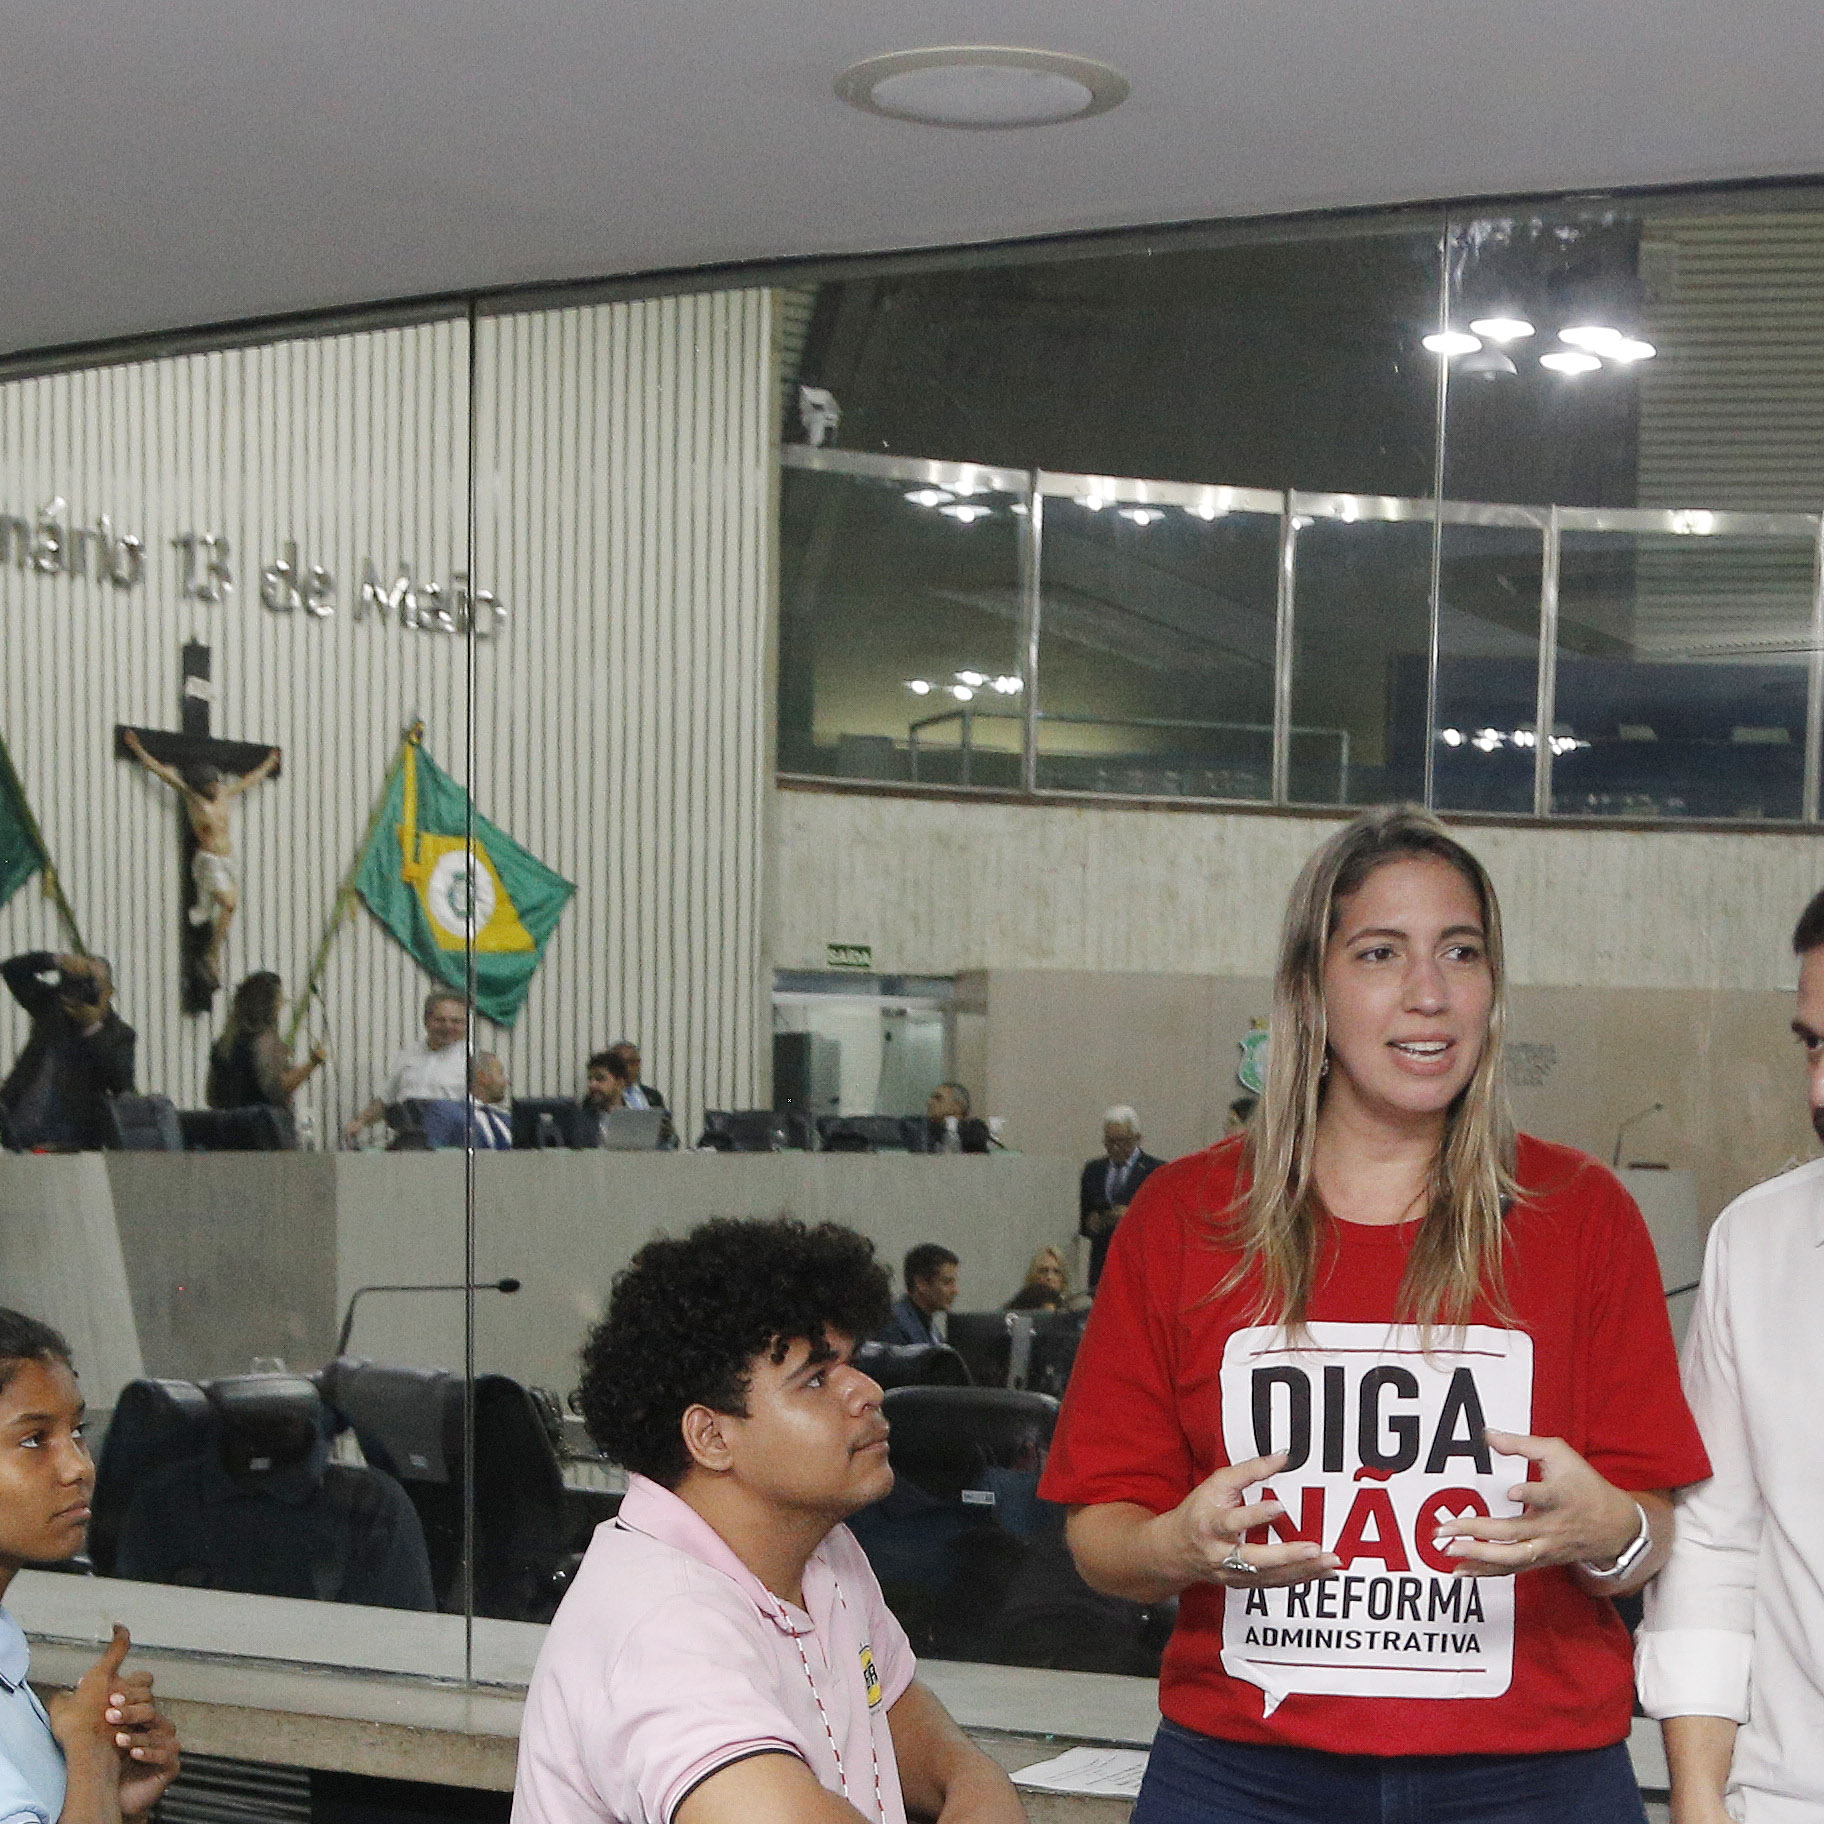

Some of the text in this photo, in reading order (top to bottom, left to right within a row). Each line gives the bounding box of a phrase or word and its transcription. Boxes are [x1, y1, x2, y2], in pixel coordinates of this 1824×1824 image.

[171, 531, 234, 603] 13
[261, 540, 336, 619] de
[350, 556, 509, 642] Maio
[1251, 1365, 1493, 1474] DIGA
[1286, 1575, 1486, 1624] REFORMA
[1244, 1626, 1482, 1654] ADMINISTRATIVA
